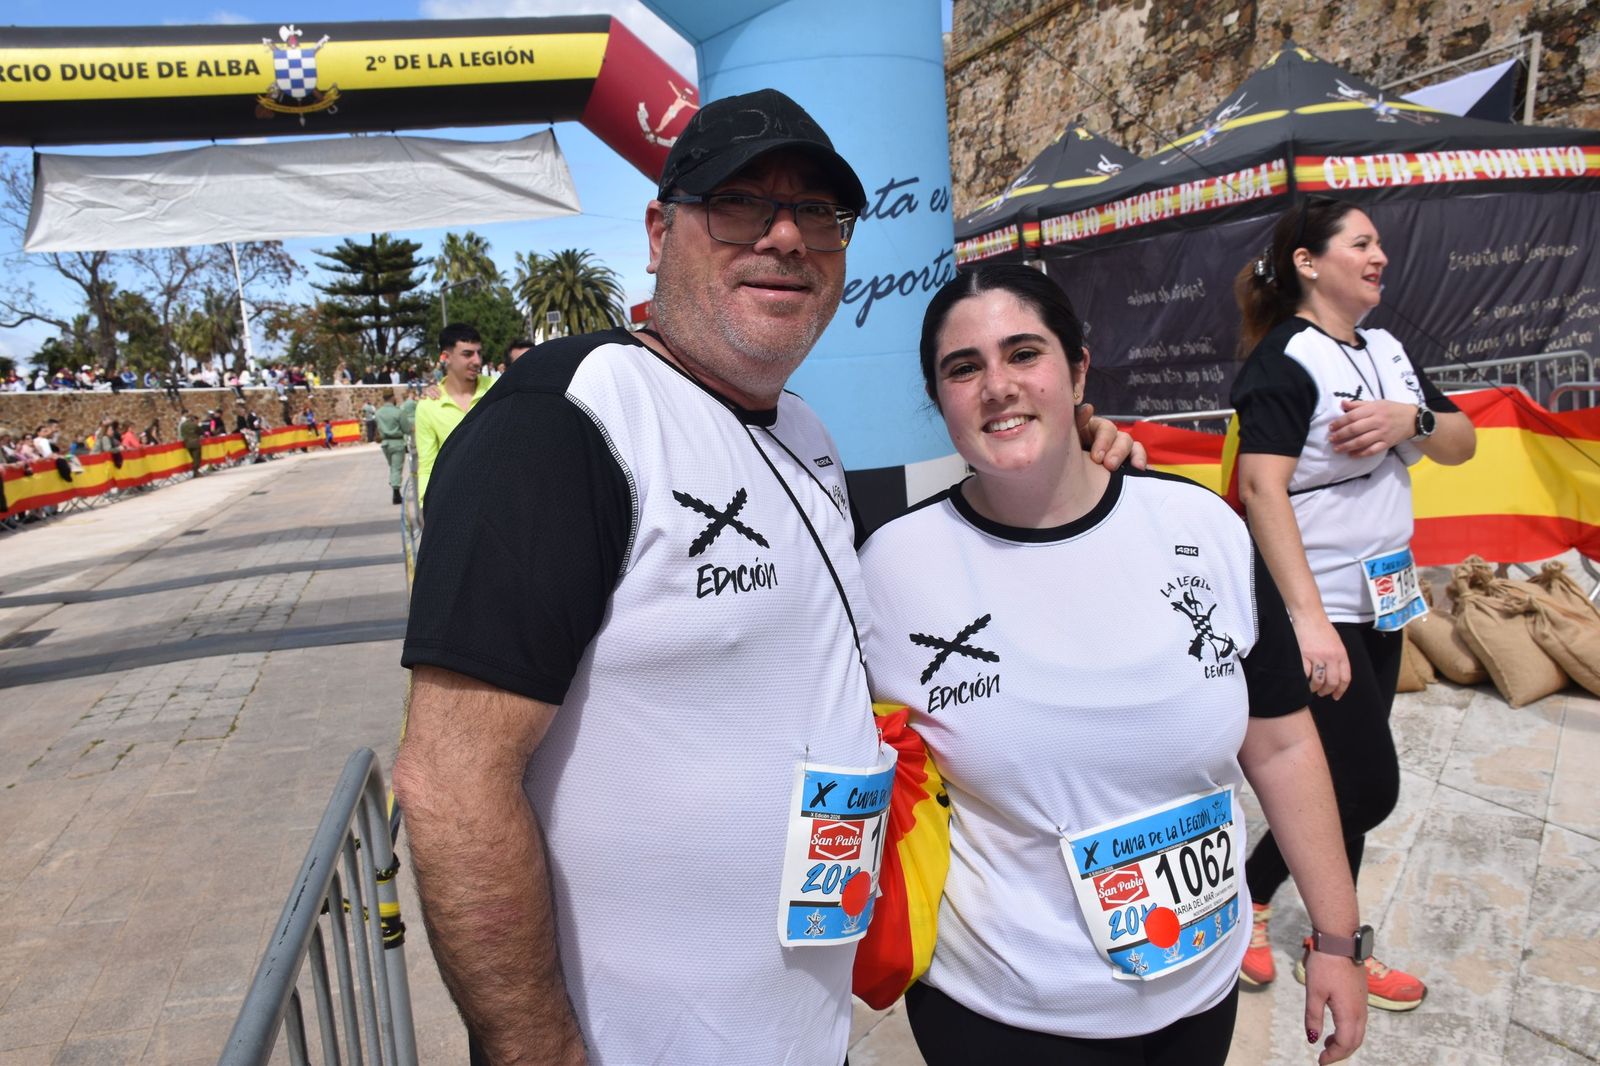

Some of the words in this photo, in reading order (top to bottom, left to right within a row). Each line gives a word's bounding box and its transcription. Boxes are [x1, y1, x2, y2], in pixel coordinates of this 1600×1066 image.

[394, 54, 421, 70] DE
[427, 53, 453, 69] LA
[459, 46, 535, 68] LEGIÓN
[60, 62, 149, 82] DUQUE
[157, 61, 189, 78] DE
[196, 59, 260, 78] ALBA
[1323, 152, 1413, 189] CLUB
[1415, 146, 1587, 184] DEPORTIVO
[1041, 206, 1100, 246] TERCIO
[1180, 179, 1206, 214] DE
[1176, 546, 1198, 556] 42K
[1204, 662, 1235, 679] CEUTA
[809, 780, 838, 808] X
[811, 833, 832, 848] San
[835, 834, 862, 847] Pablo
[1083, 840, 1100, 870] X
[1155, 830, 1235, 905] 1062
[1098, 885, 1118, 899] San
[1118, 876, 1145, 892] Pablo
[1193, 898, 1205, 910] DEL
[1204, 891, 1216, 903] MAR
